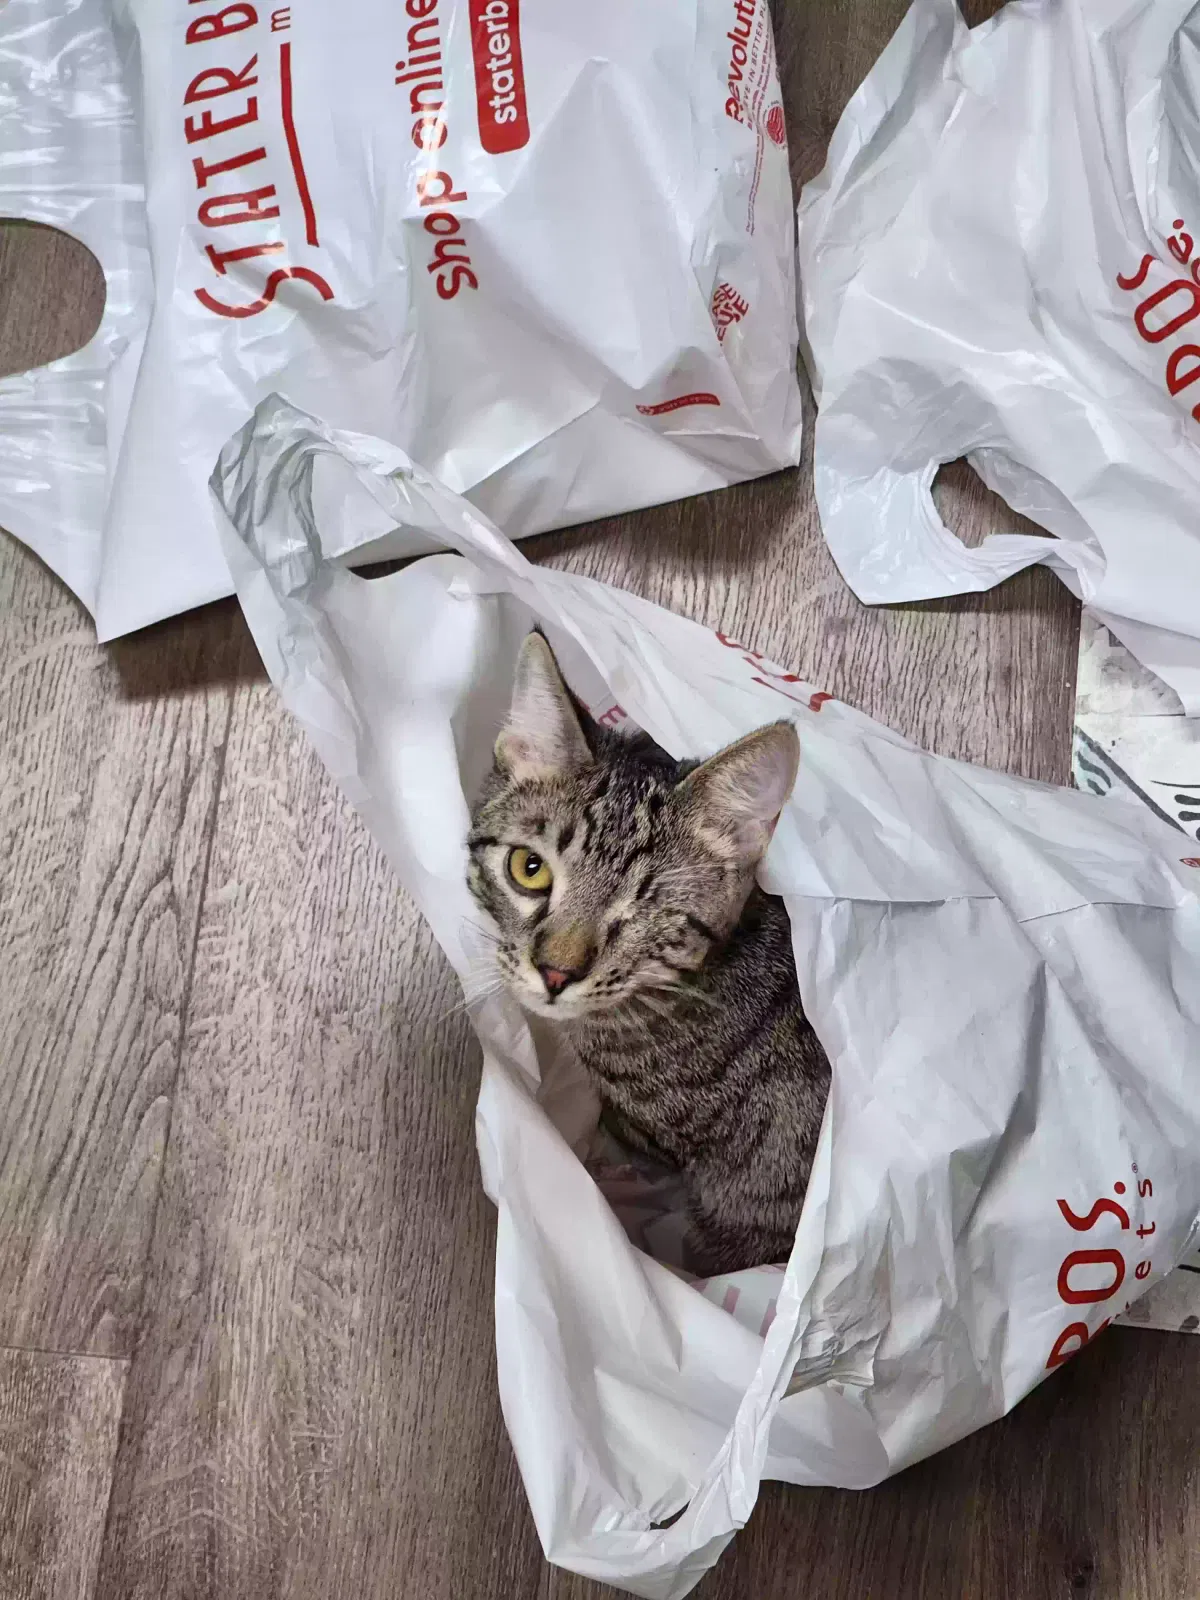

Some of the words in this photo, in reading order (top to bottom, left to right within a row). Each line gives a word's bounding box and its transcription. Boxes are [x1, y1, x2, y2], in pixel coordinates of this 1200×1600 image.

[185, 0, 259, 45] B
[395, 0, 448, 149] online
[478, 0, 518, 124] staterb
[725, 0, 756, 124] Revolut
[751, 21, 763, 67] BETTER
[183, 52, 335, 319] STATER
[416, 170, 479, 300] shop
